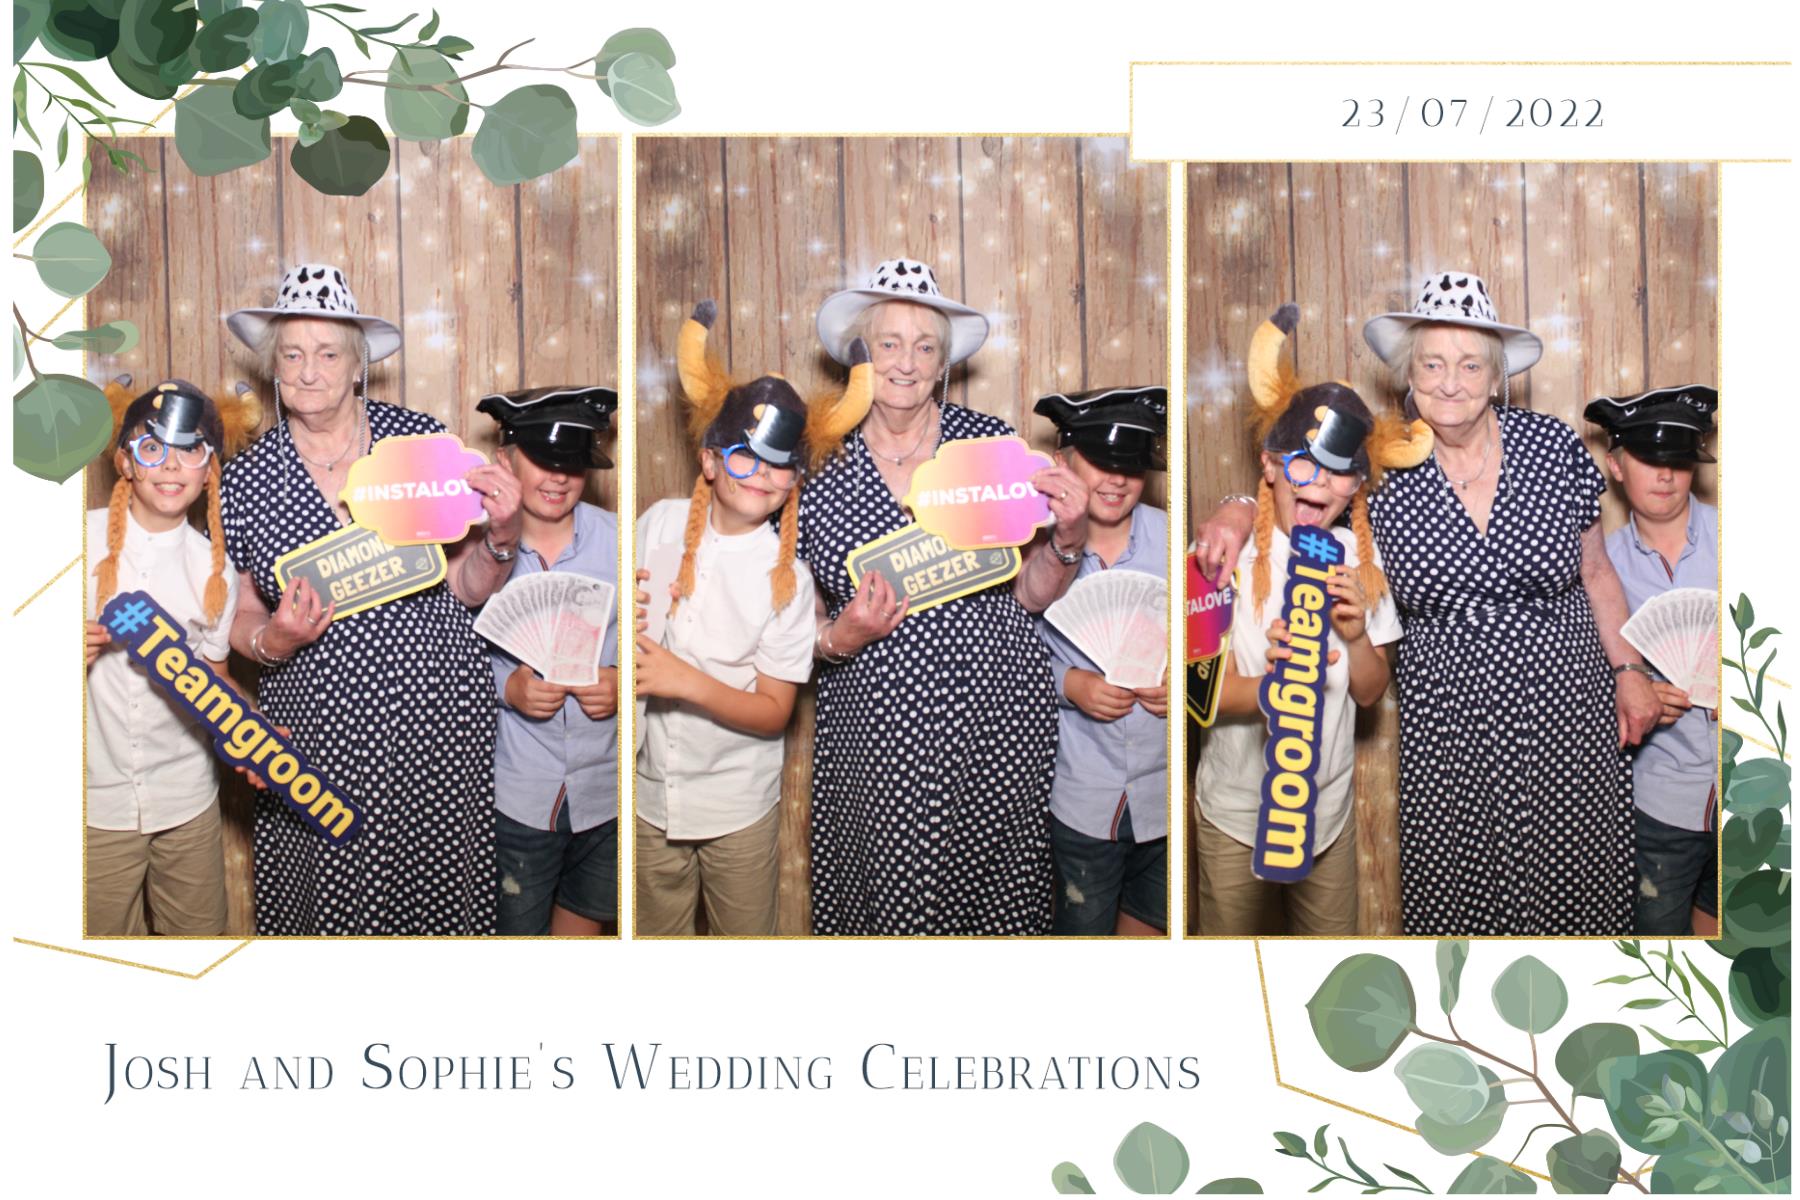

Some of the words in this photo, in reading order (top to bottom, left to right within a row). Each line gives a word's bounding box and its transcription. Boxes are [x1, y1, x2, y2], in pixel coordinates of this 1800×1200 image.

[352, 479, 473, 503] #INSTALOV
[917, 481, 1039, 507] #INSTALOV
[316, 535, 396, 578] DIAMON
[889, 535, 953, 573] DIAMO
[902, 550, 981, 596] GEEZER
[329, 556, 407, 602] GEEZER
[109, 599, 355, 839] #Teamgroom
[1264, 533, 1338, 869] #Teamgroom
